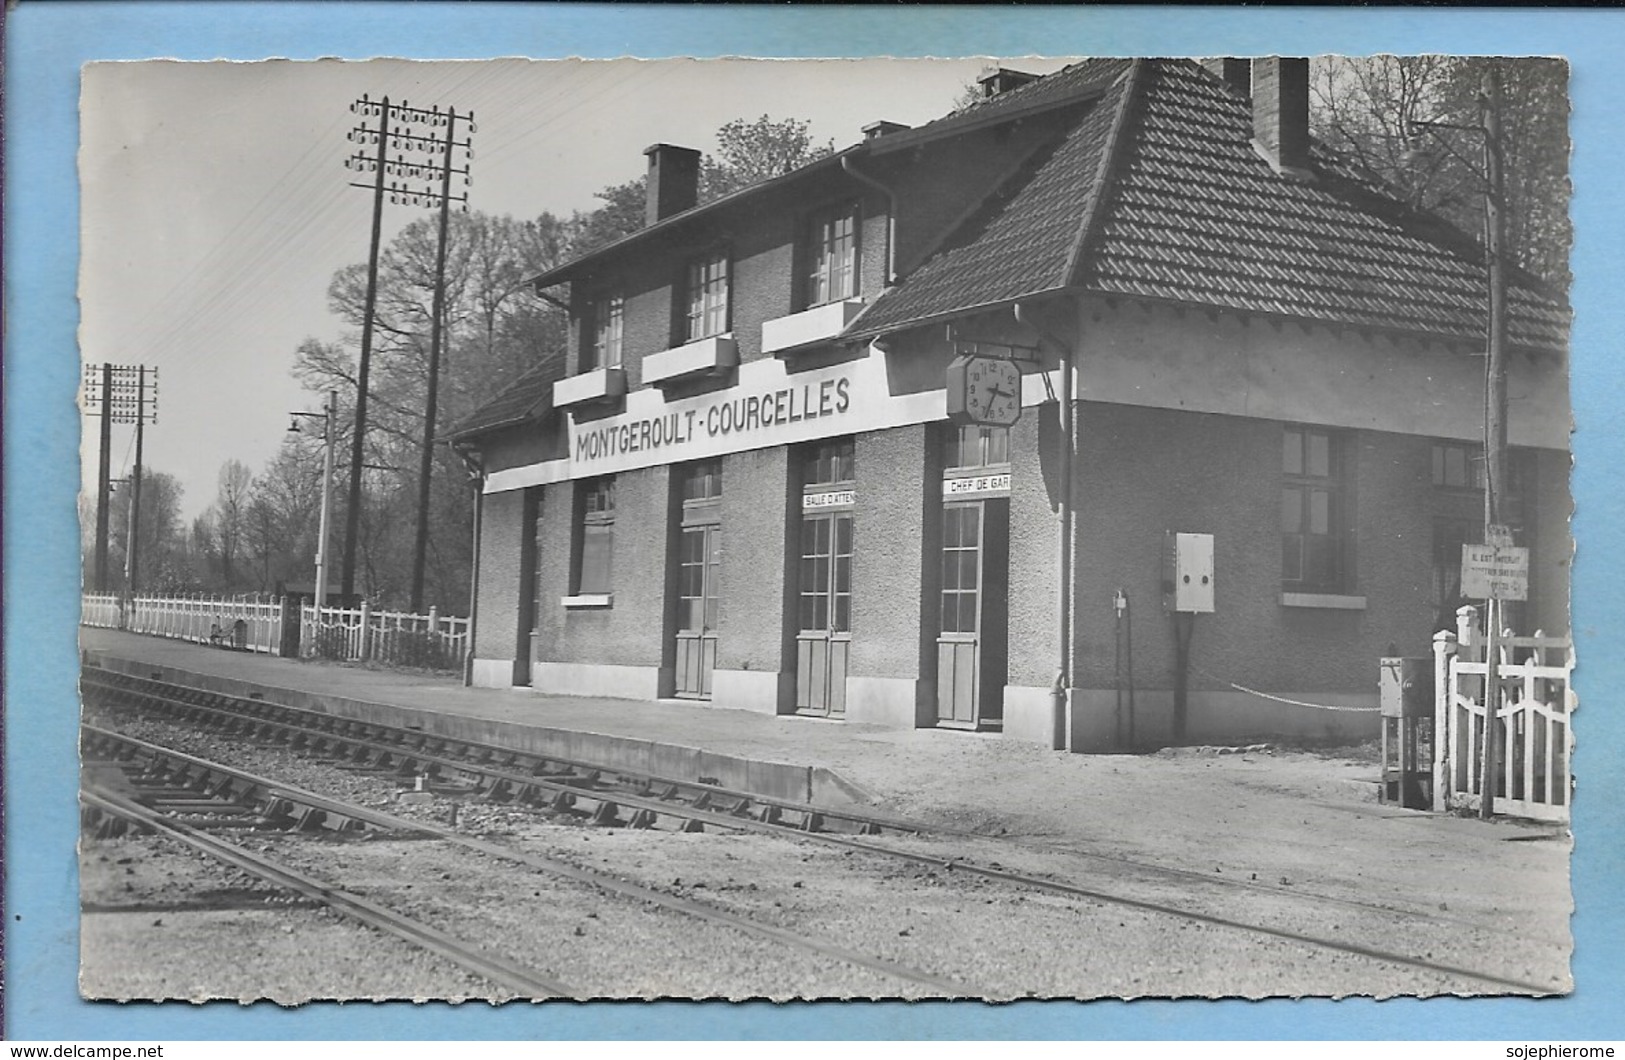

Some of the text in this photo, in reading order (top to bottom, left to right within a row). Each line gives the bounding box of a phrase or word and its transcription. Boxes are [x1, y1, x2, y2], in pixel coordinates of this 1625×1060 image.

[970, 384, 976, 395] 9
[951, 480, 973, 492] CHEF
[977, 479, 988, 491] DE
[806, 495, 826, 506] SALLE
